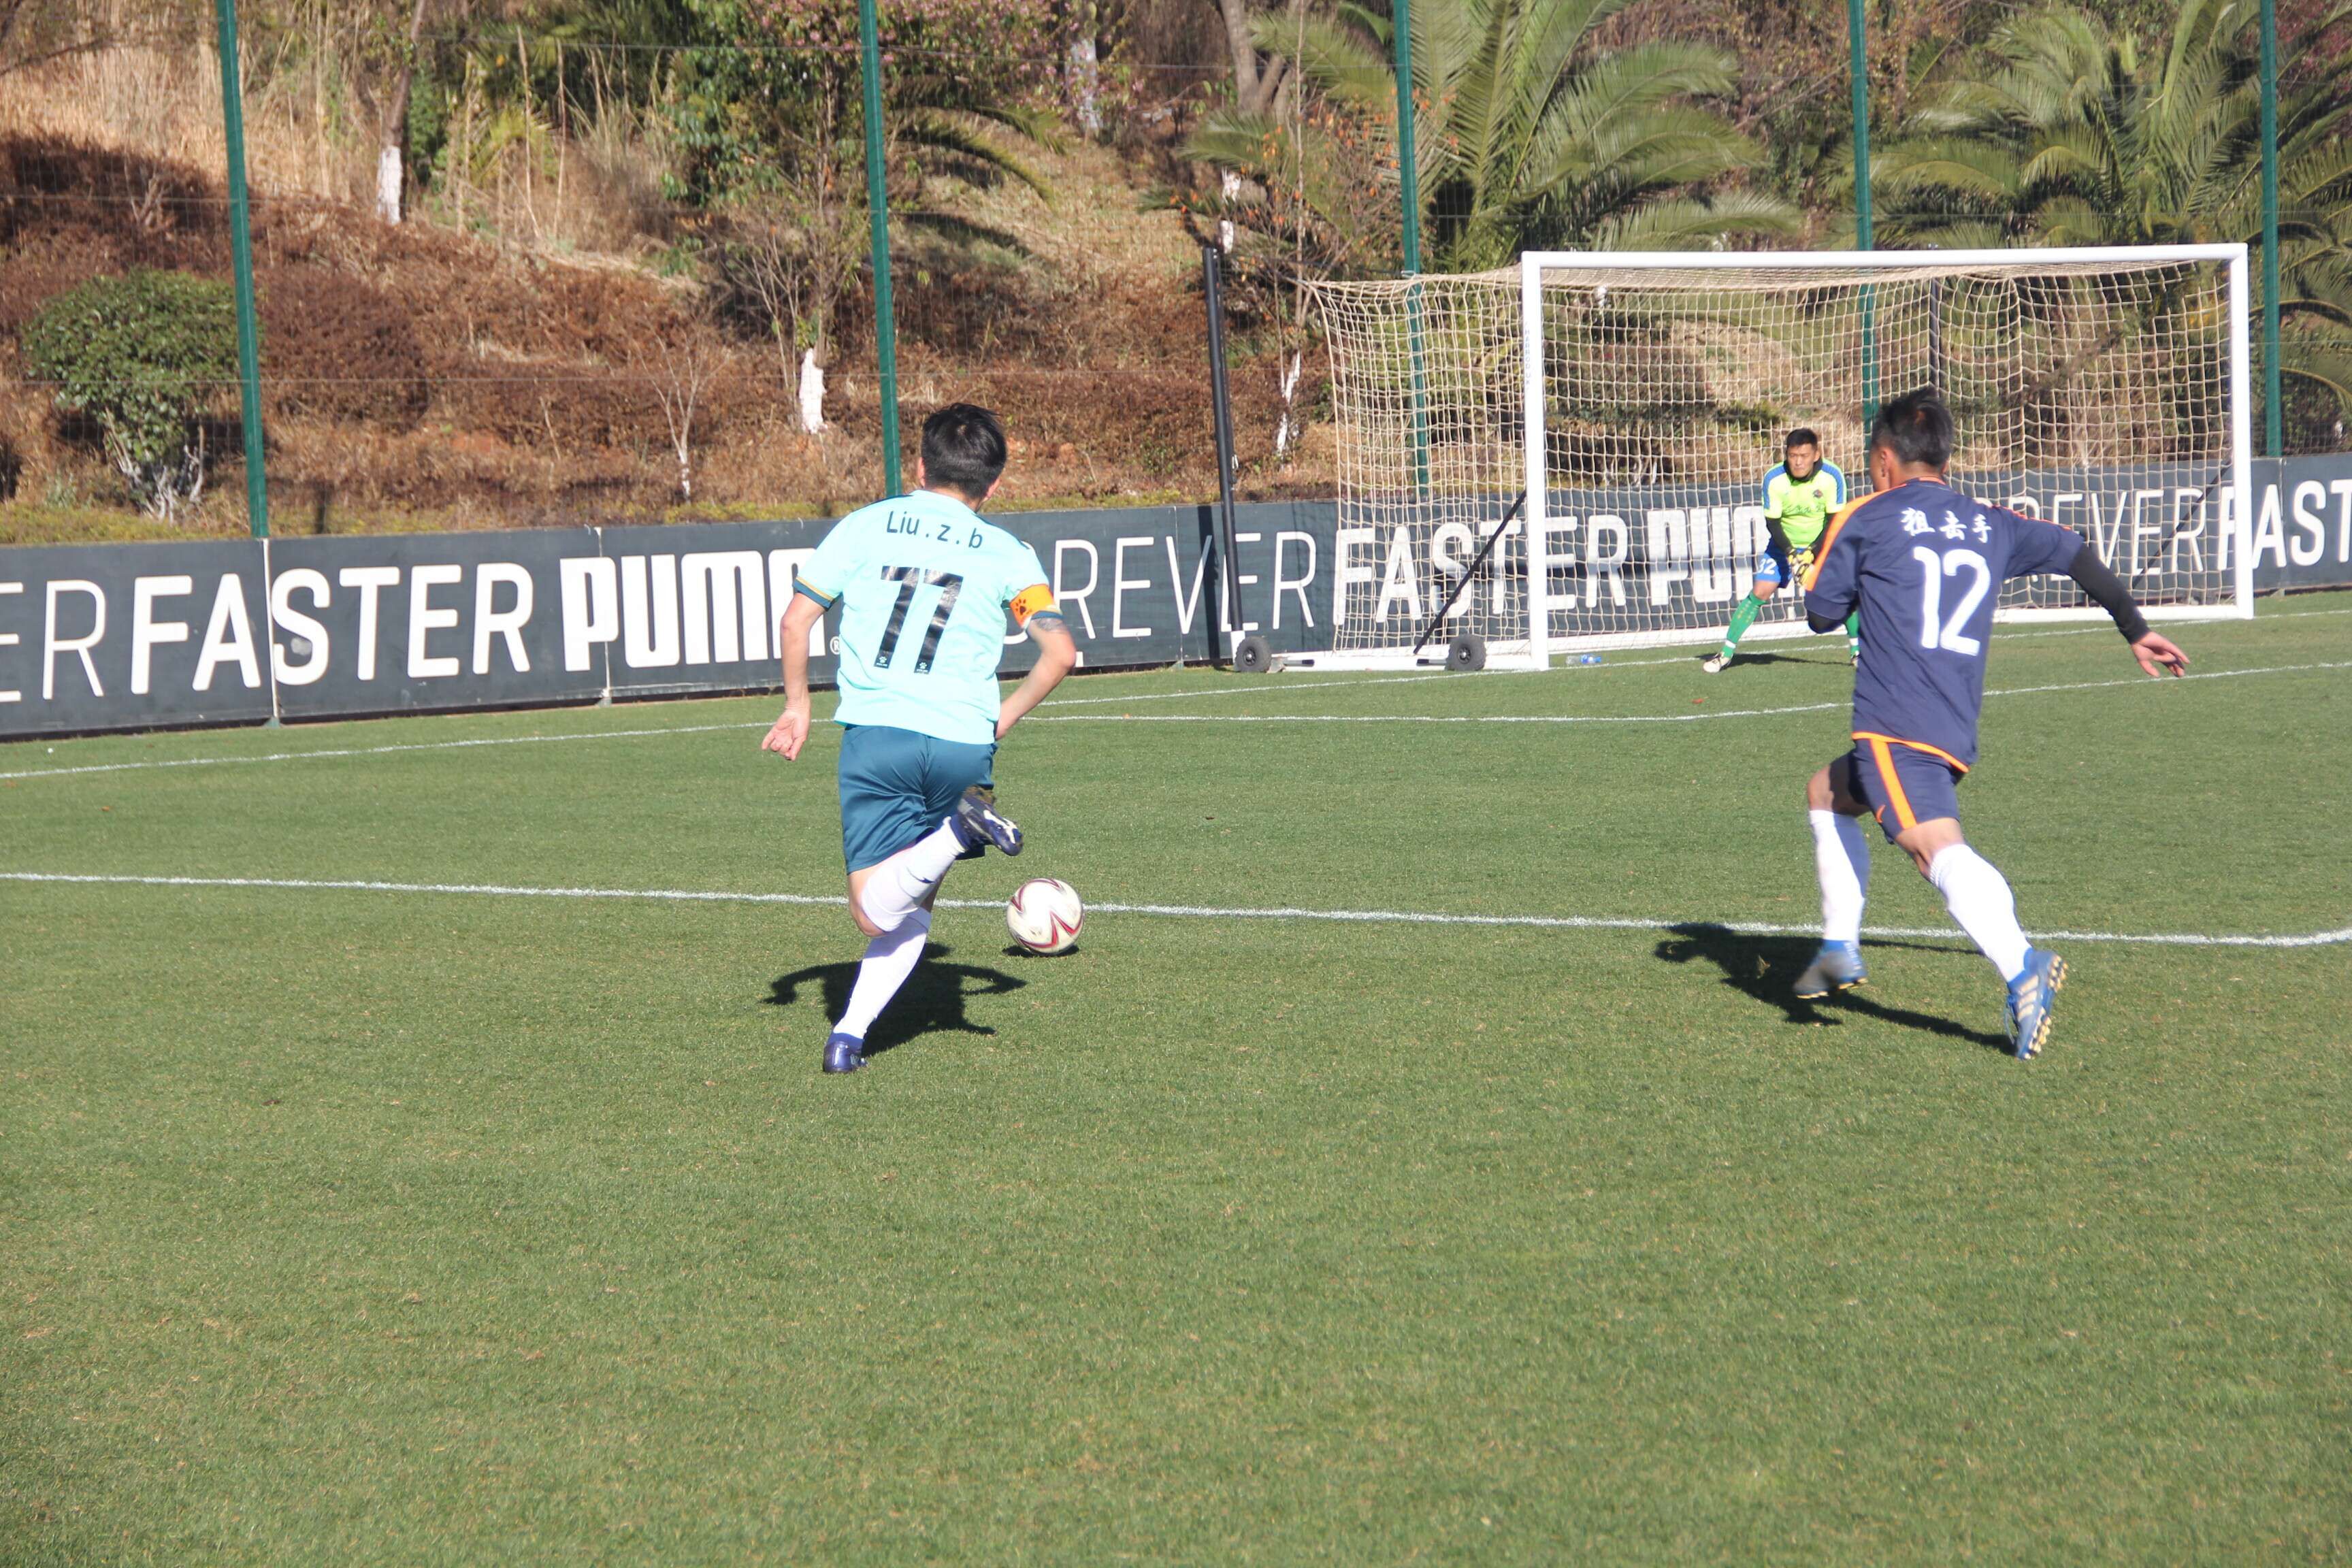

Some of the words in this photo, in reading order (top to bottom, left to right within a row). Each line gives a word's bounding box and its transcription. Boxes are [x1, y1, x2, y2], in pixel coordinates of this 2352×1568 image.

[131, 563, 533, 694] FASTER
[1333, 514, 1627, 627] FASTER
[874, 566, 964, 674] 77
[1913, 546, 1991, 656] 12
